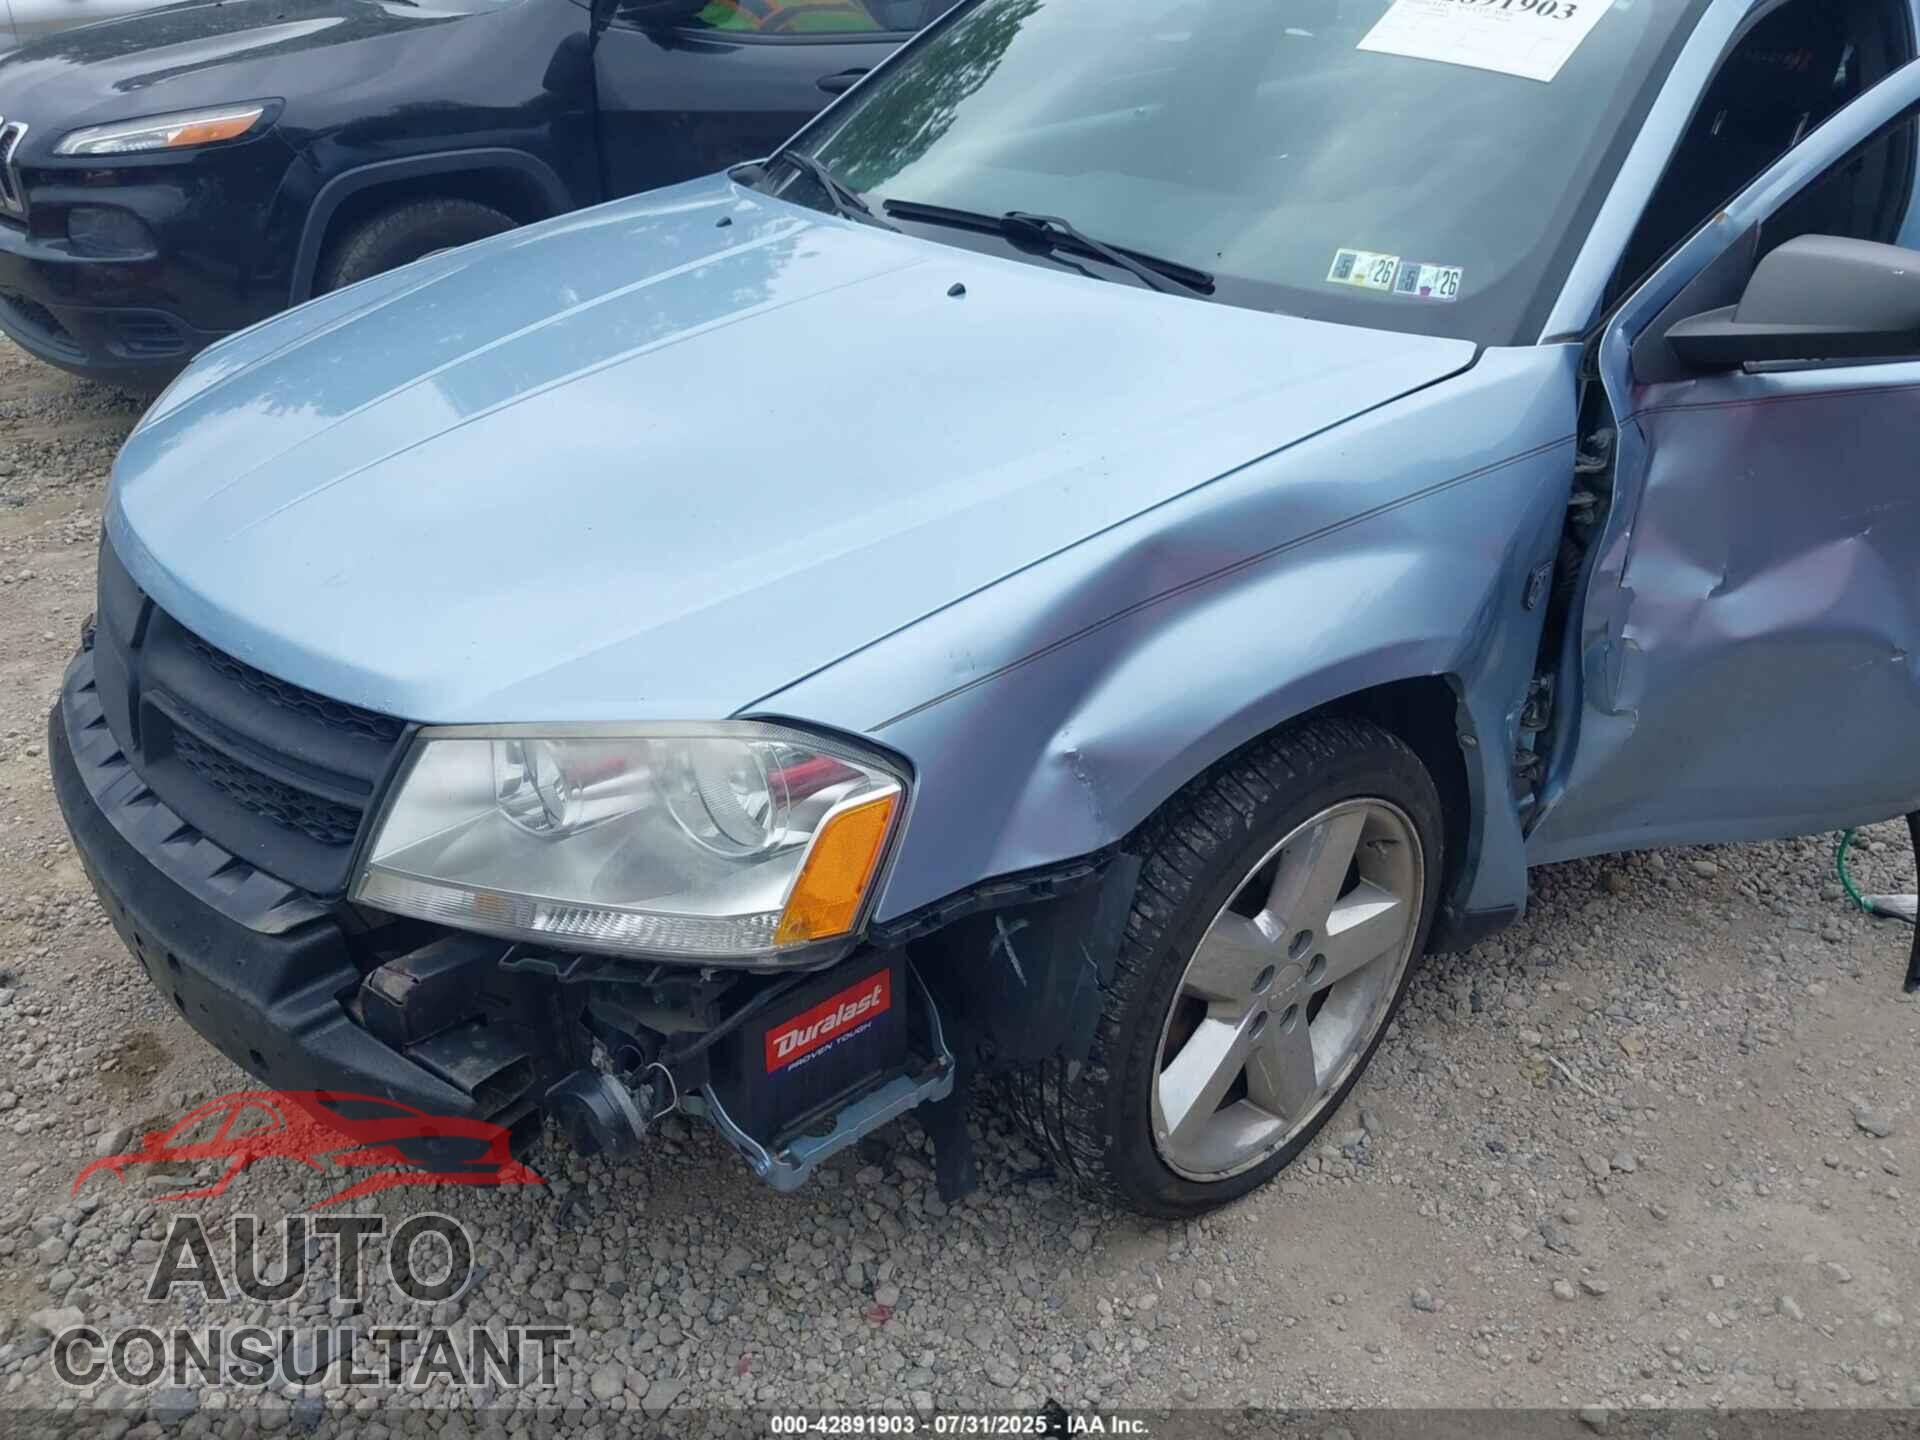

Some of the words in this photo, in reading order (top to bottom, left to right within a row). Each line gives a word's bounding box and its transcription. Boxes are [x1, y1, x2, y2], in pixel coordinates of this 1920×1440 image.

[1374, 259, 1394, 284] 26
[1439, 270, 1459, 296] 26
[773, 985, 882, 1059] Duralast
[787, 1041, 833, 1072] PROVEN
[836, 1021, 873, 1045] TOUGH
